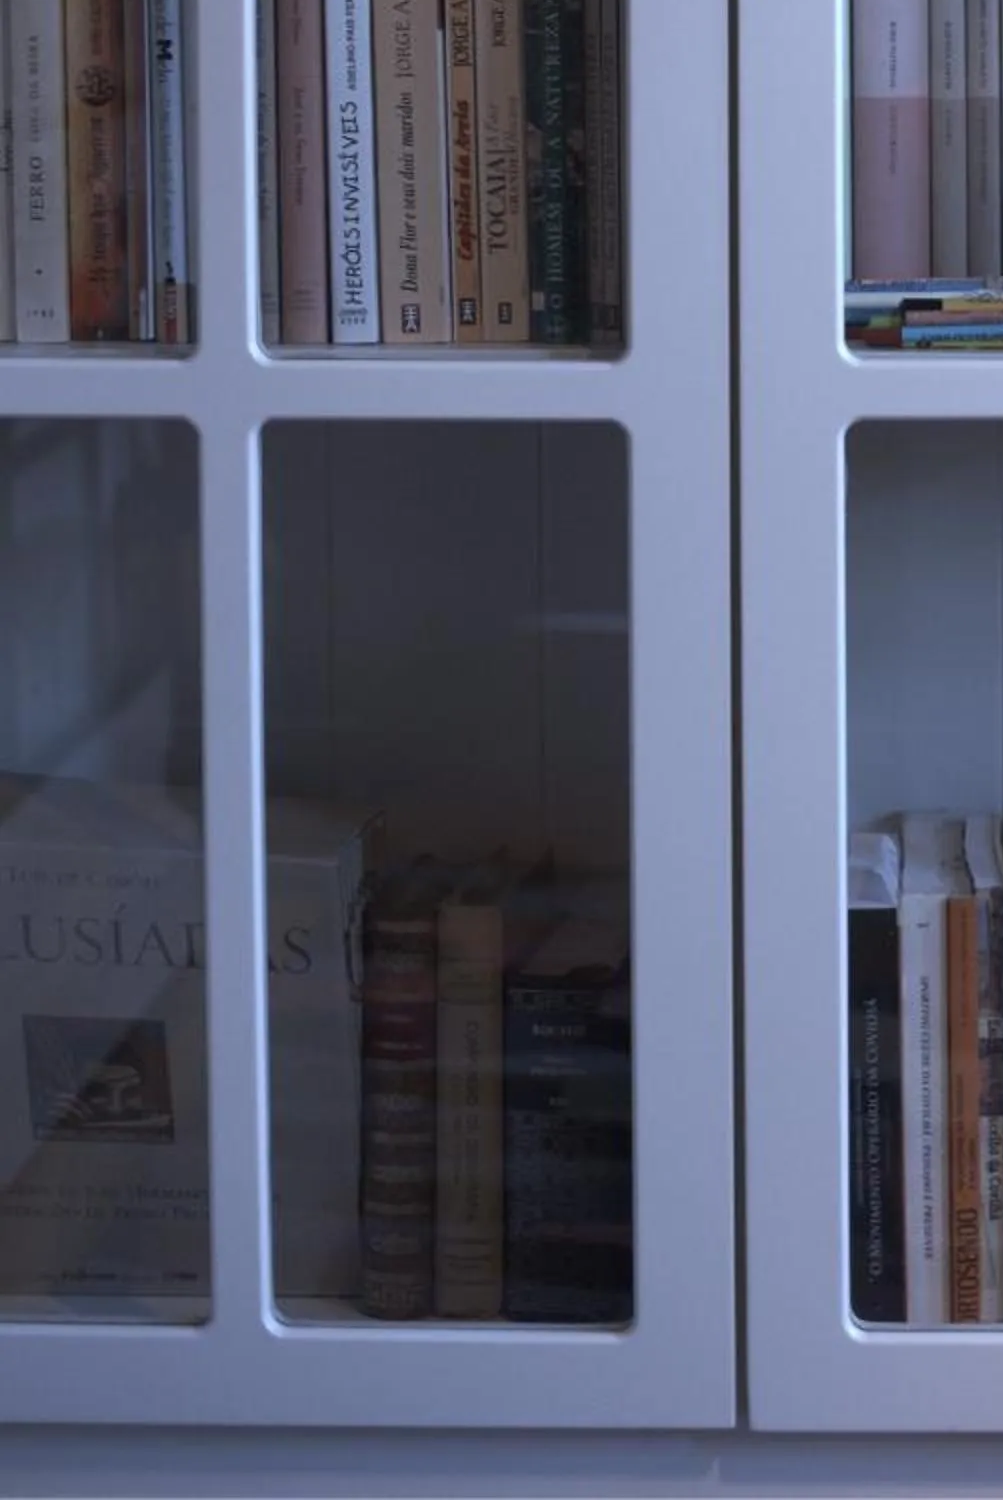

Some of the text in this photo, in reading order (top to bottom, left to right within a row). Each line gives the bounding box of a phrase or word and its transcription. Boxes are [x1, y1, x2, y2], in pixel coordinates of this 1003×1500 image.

[394, 20, 415, 78] JORGE
[452, 18, 471, 68] JORGE
[491, 8, 507, 49] JORGE
[396, 92, 415, 148] maridos
[28, 156, 44, 222] FERRO
[397, 152, 416, 181] dois
[453, 154, 471, 180] da
[337, 101, 364, 306] HERÓIS INVISÍVEIS
[403, 182, 417, 211] seus
[486, 157, 508, 256] TOCAIA
[399, 224, 419, 253] Flor
[546, 201, 563, 283] HOMEM
[399, 255, 419, 294] Dona
